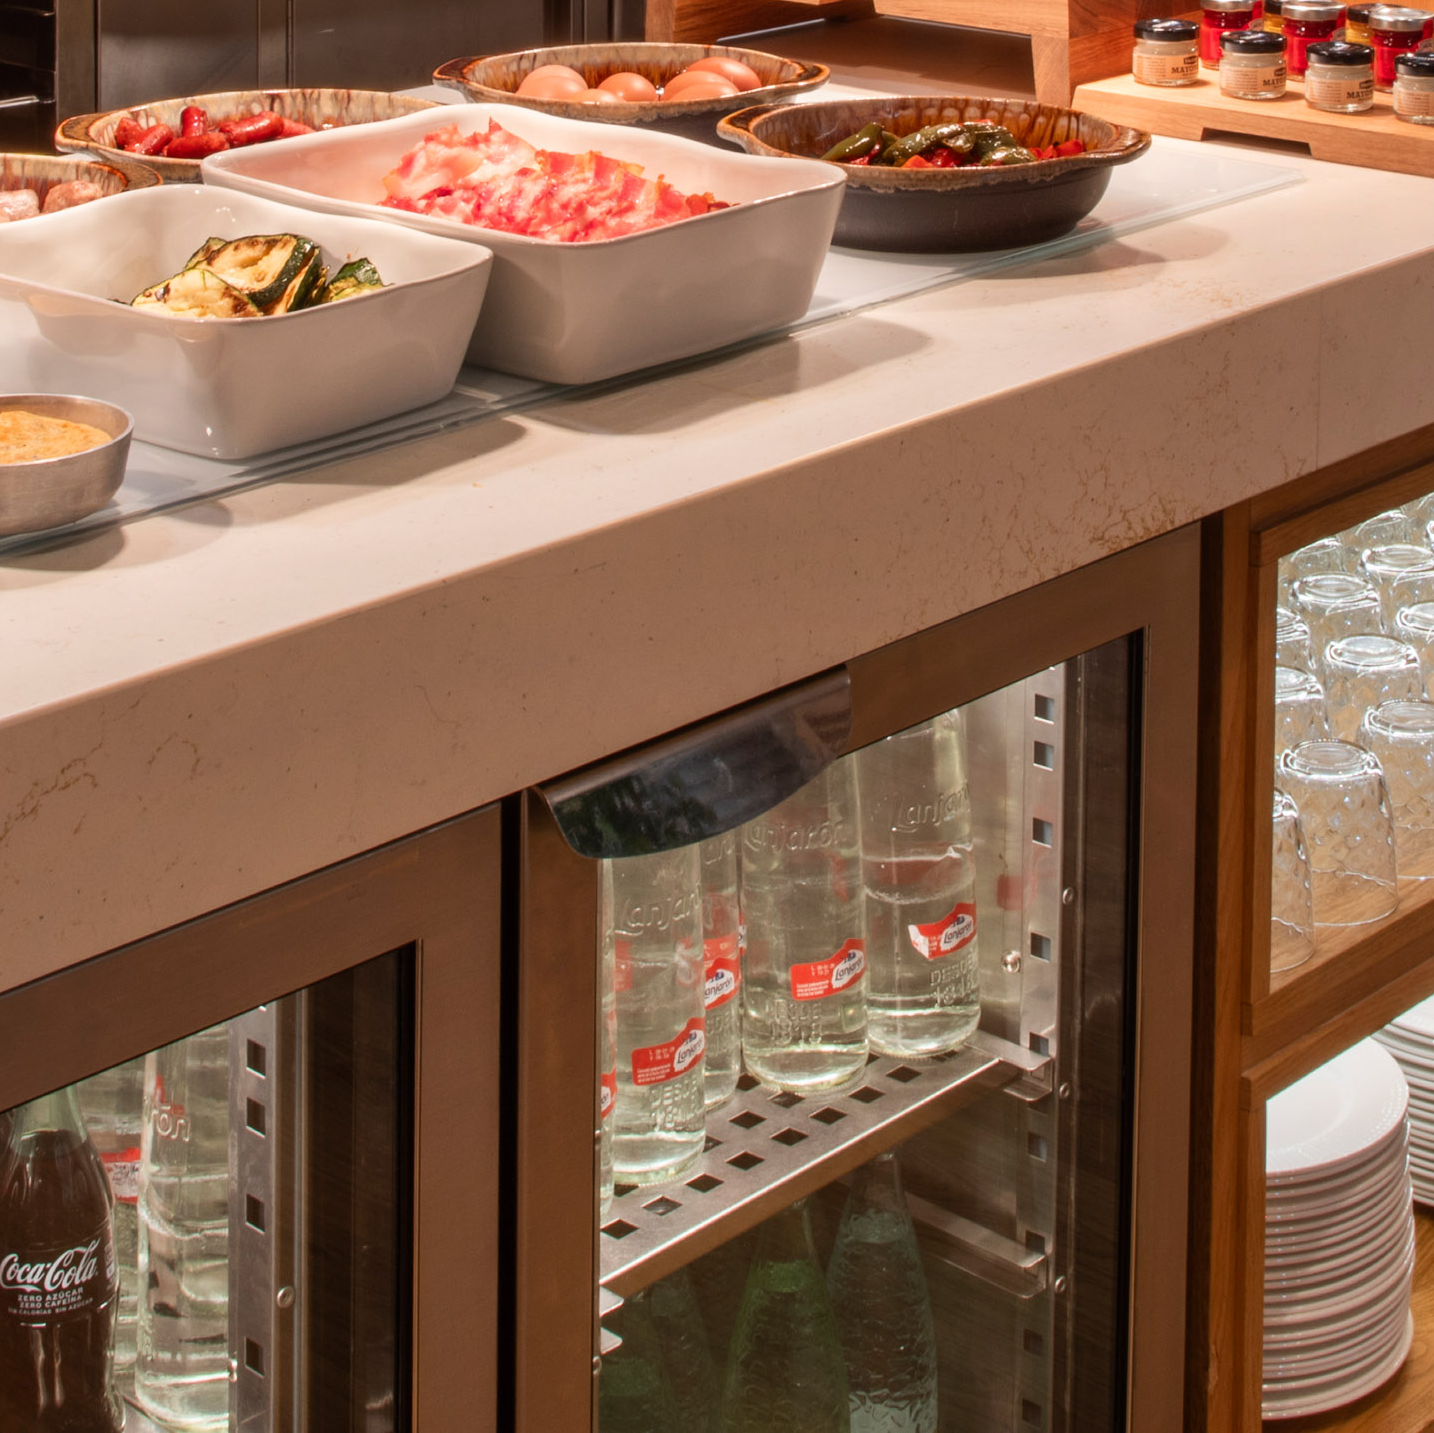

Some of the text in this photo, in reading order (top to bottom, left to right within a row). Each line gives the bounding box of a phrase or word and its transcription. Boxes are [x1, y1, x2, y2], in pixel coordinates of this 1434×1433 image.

[1171, 65, 1198, 74] MAYO
[1262, 74, 1286, 86] MAYO
[1346, 89, 1373, 99] MAYO
[18, 1294, 42, 1302] ZERO
